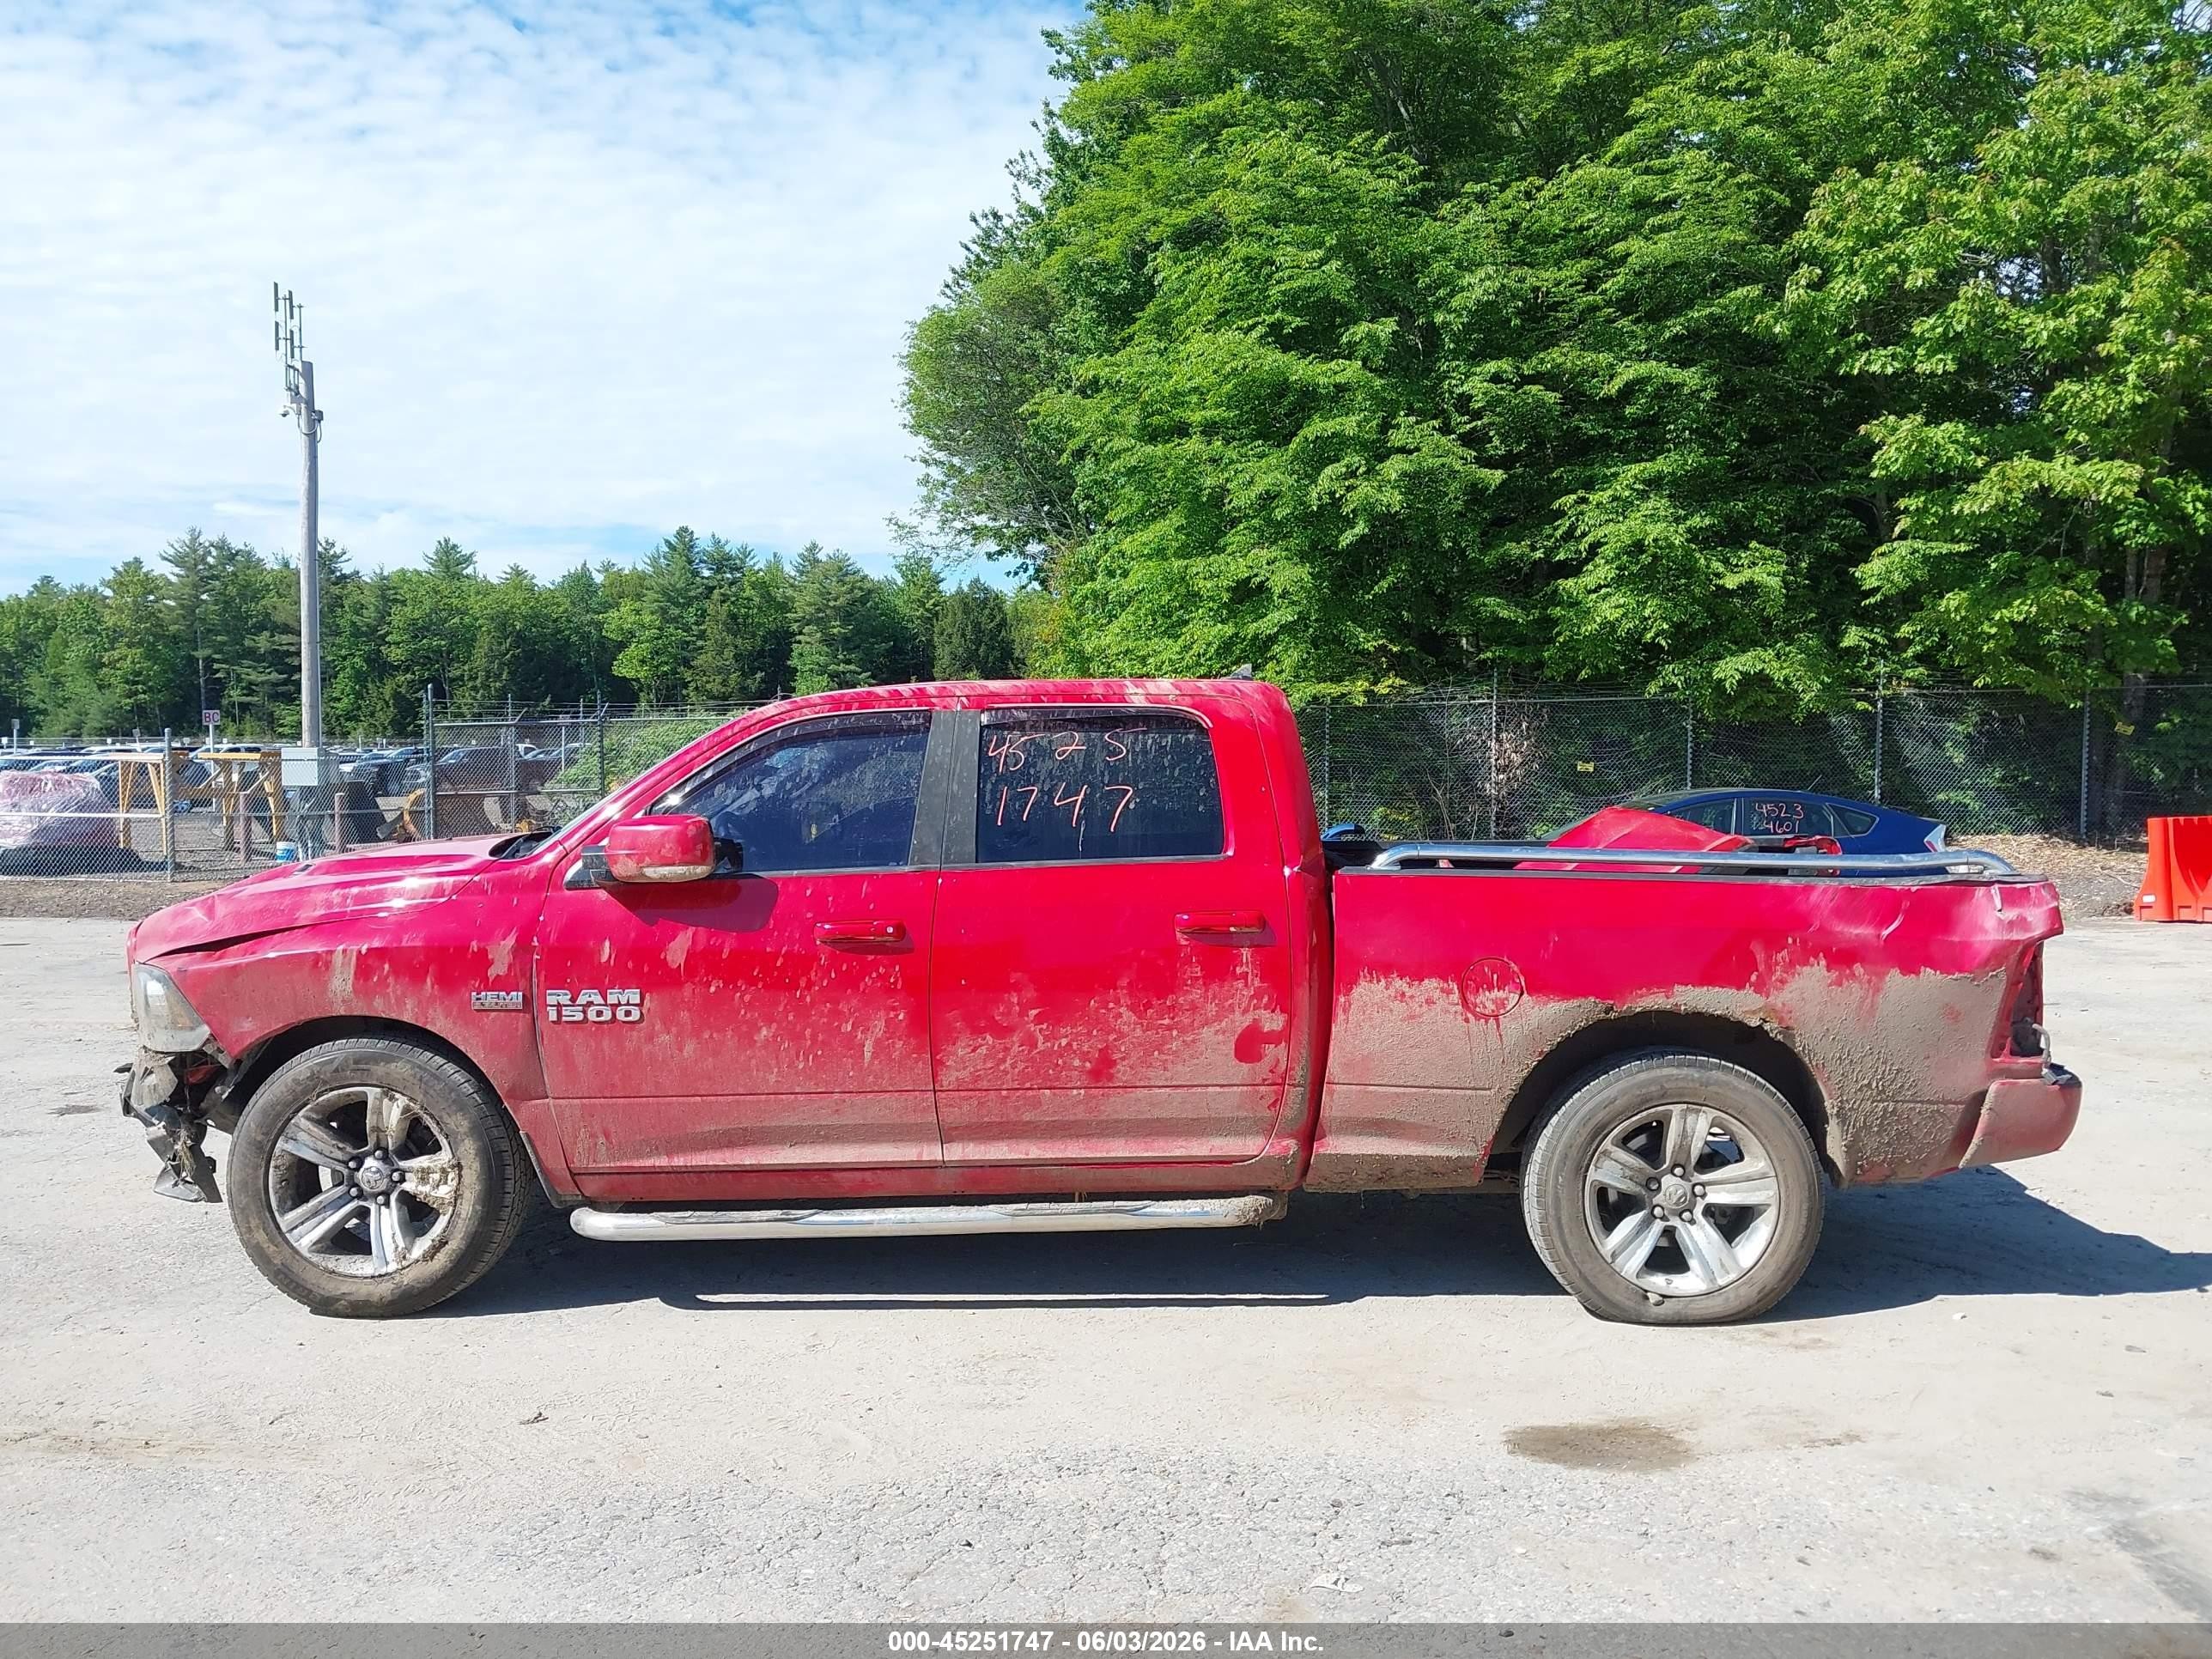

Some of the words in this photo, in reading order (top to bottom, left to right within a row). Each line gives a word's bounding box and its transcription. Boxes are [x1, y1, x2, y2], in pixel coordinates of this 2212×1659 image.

[204, 712, 220, 723] BC
[996, 782, 1133, 833] 1747
[1755, 802, 1804, 819] 4523
[1763, 820, 1800, 834] 4601
[471, 991, 522, 1002] HEMI
[546, 989, 641, 1006] RAM
[547, 1006, 641, 1023] 1500
